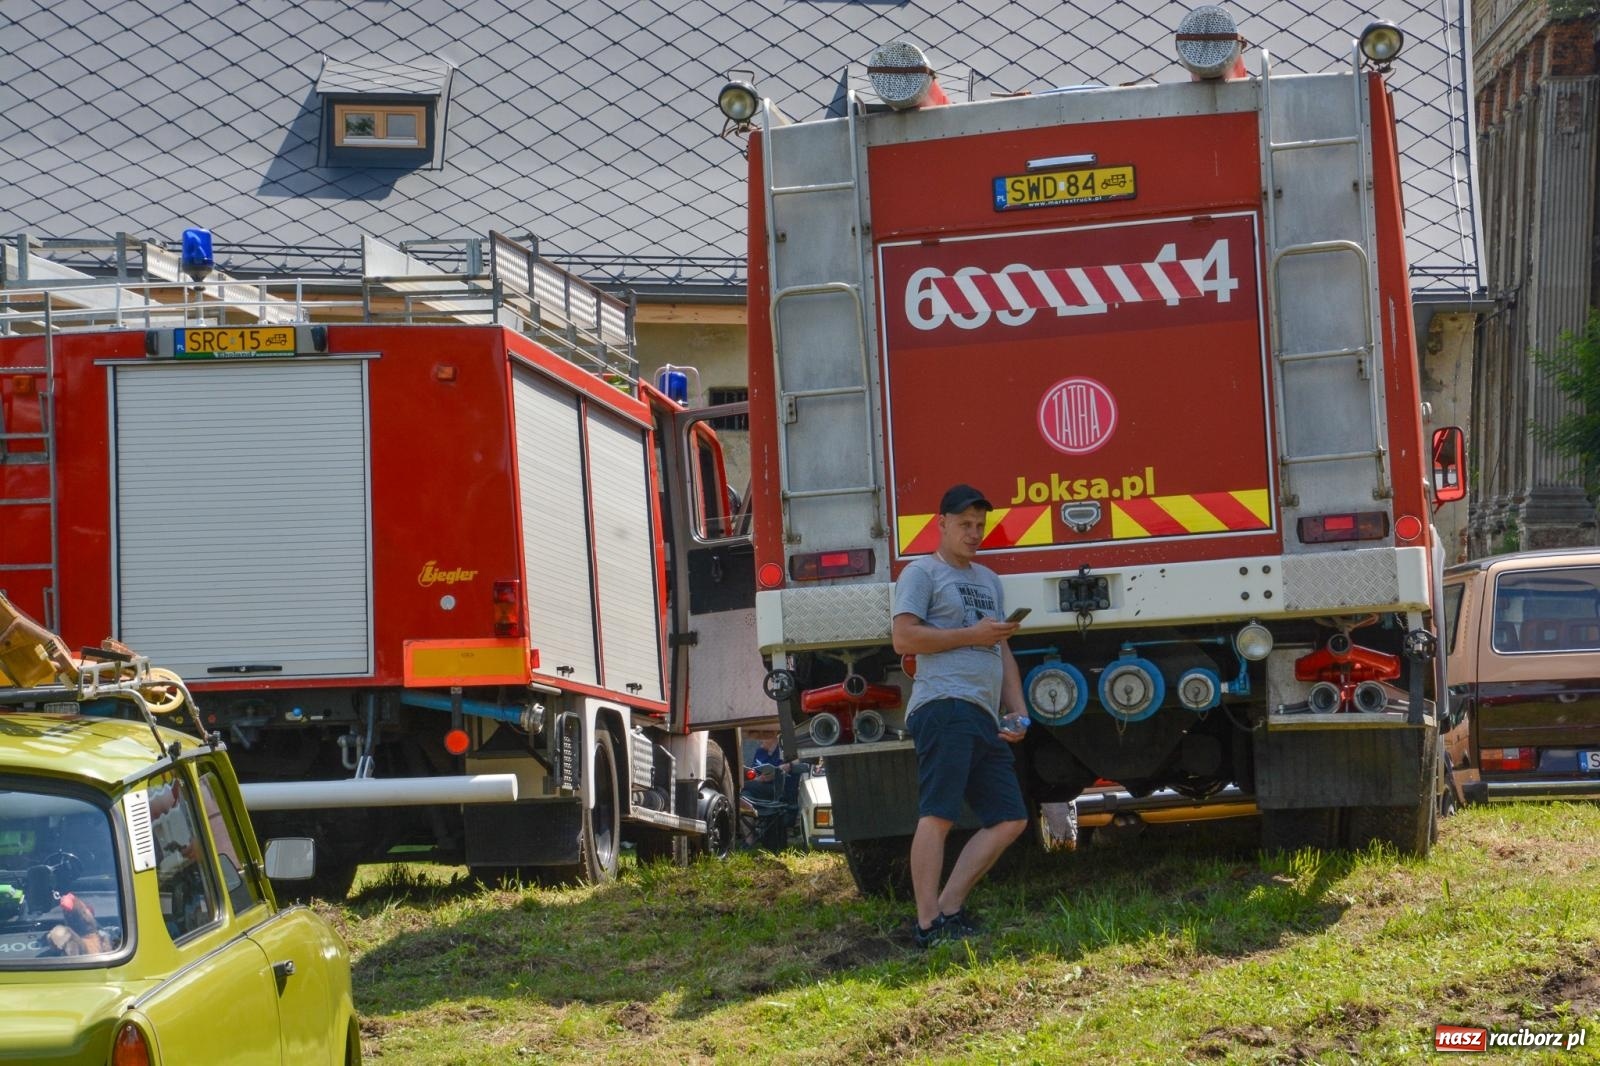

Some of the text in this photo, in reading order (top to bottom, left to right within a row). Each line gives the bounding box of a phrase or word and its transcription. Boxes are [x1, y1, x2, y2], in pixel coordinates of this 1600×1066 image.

[1010, 171, 1097, 203] SWD 84
[188, 330, 262, 352] SRC 15
[1010, 466, 1156, 505] Joksa.pl
